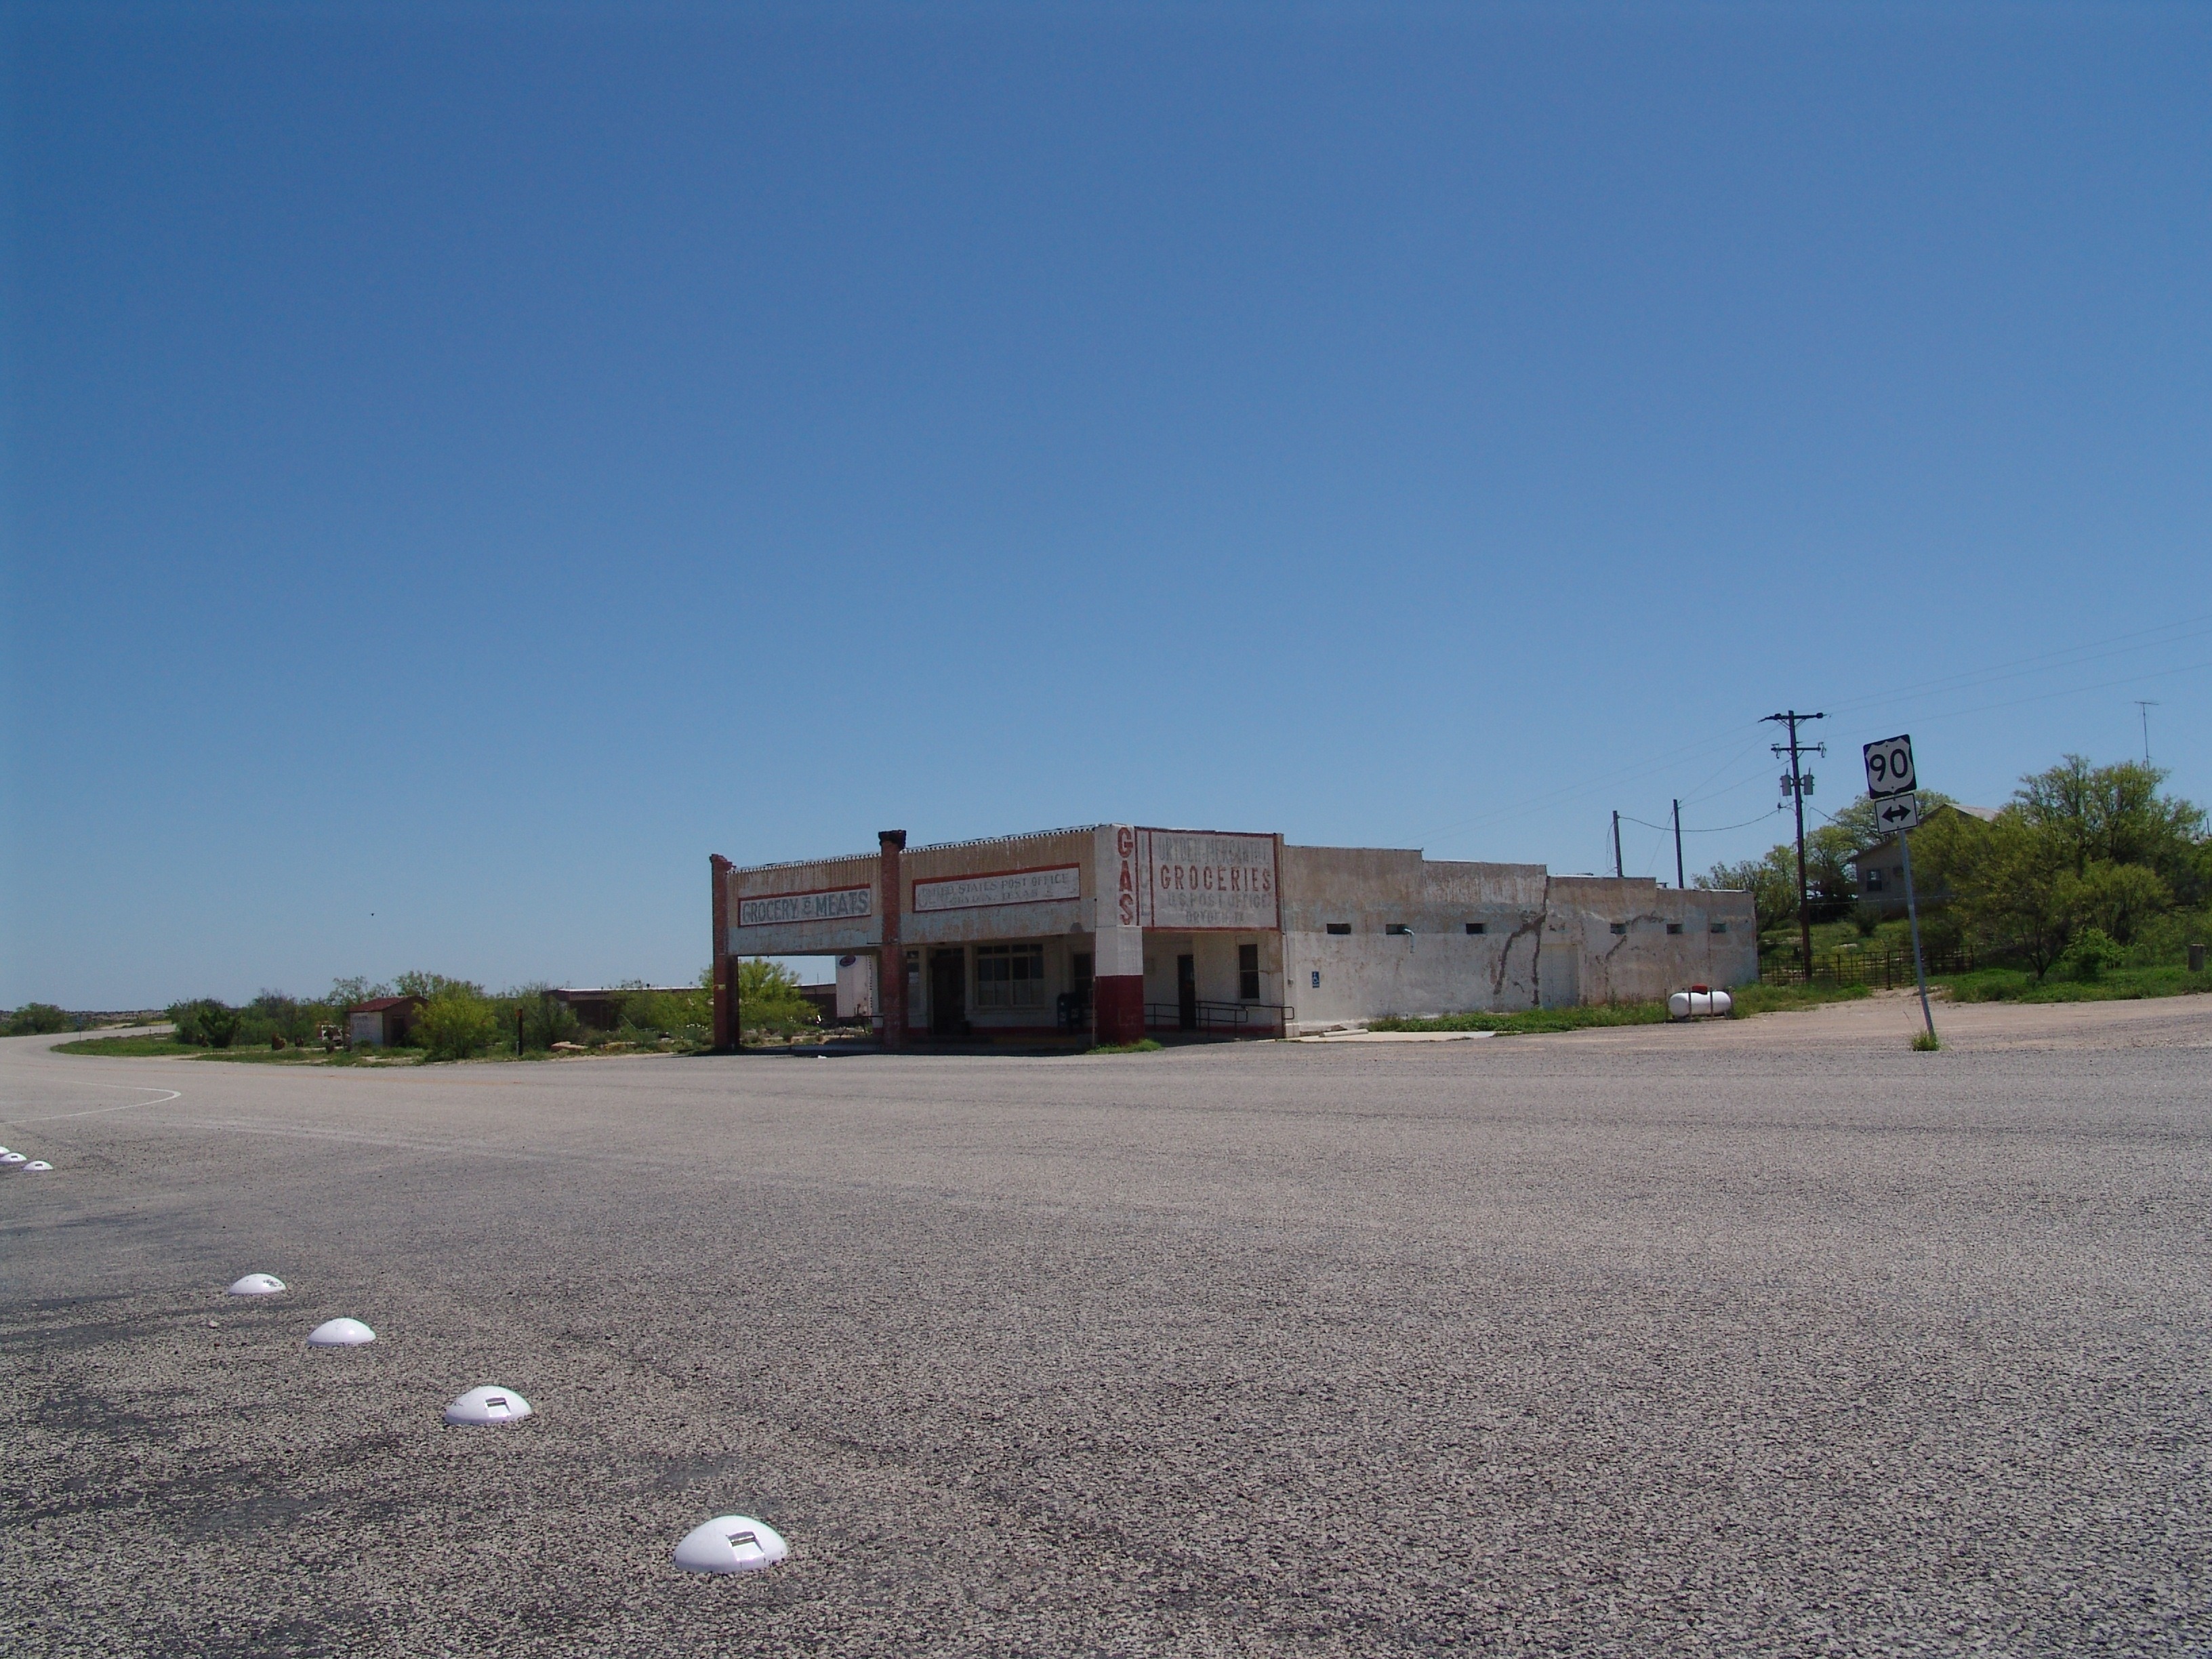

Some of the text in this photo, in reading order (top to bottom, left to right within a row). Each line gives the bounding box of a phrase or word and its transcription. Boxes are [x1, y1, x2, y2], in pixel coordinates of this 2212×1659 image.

[1869, 748, 1908, 782] 90
[958, 882, 998, 895] STATES
[1002, 878, 1026, 889] POST
[1031, 873, 1069, 886] OFFICE
[1118, 827, 1134, 926] GAS
[1160, 864, 1272, 892] GROCERIES
[743, 898, 799, 923] GROCERY
[815, 890, 869, 917] MEATS
